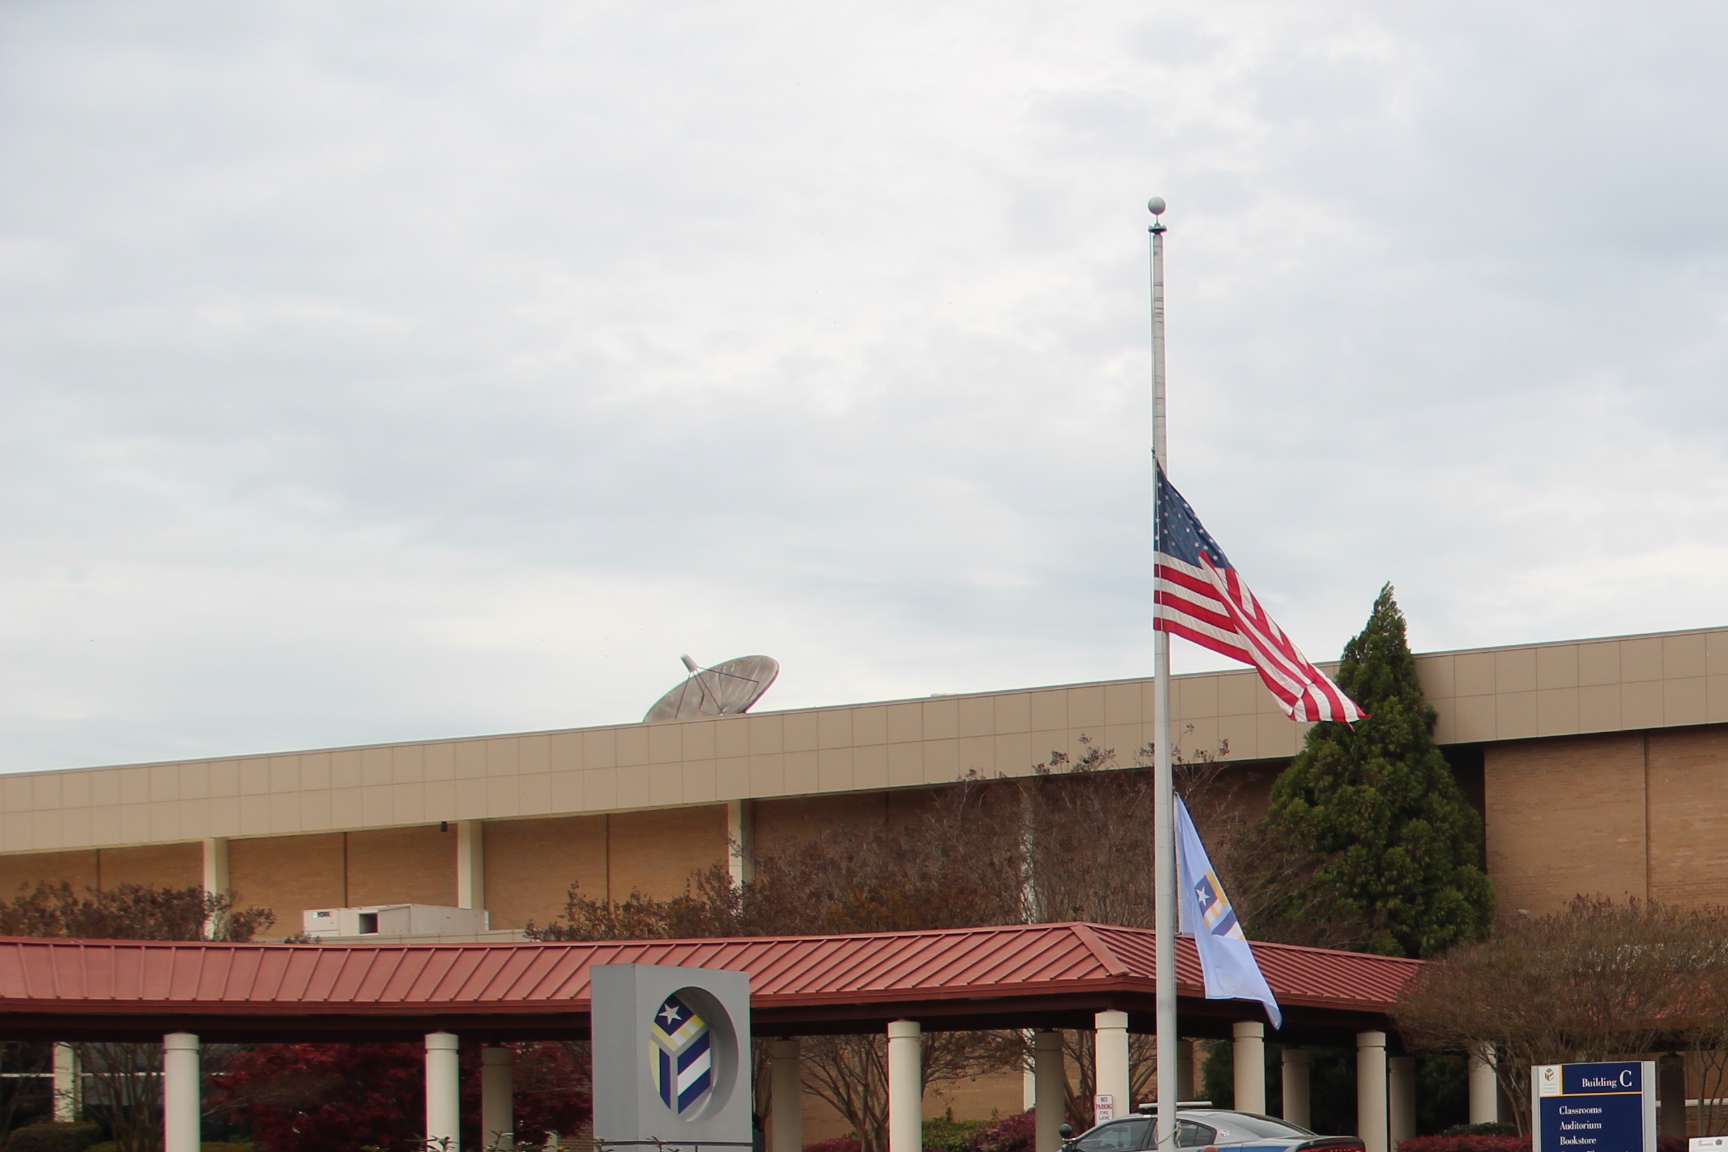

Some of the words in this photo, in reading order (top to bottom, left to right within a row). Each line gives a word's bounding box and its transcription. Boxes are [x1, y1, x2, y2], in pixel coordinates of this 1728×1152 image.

[1582, 1078, 1617, 1088] Building
[1619, 1069, 1632, 1087] C
[1559, 1105, 1602, 1115] Classrooms
[1560, 1120, 1602, 1130] Auditorium
[1560, 1136, 1597, 1146] Bookstore
